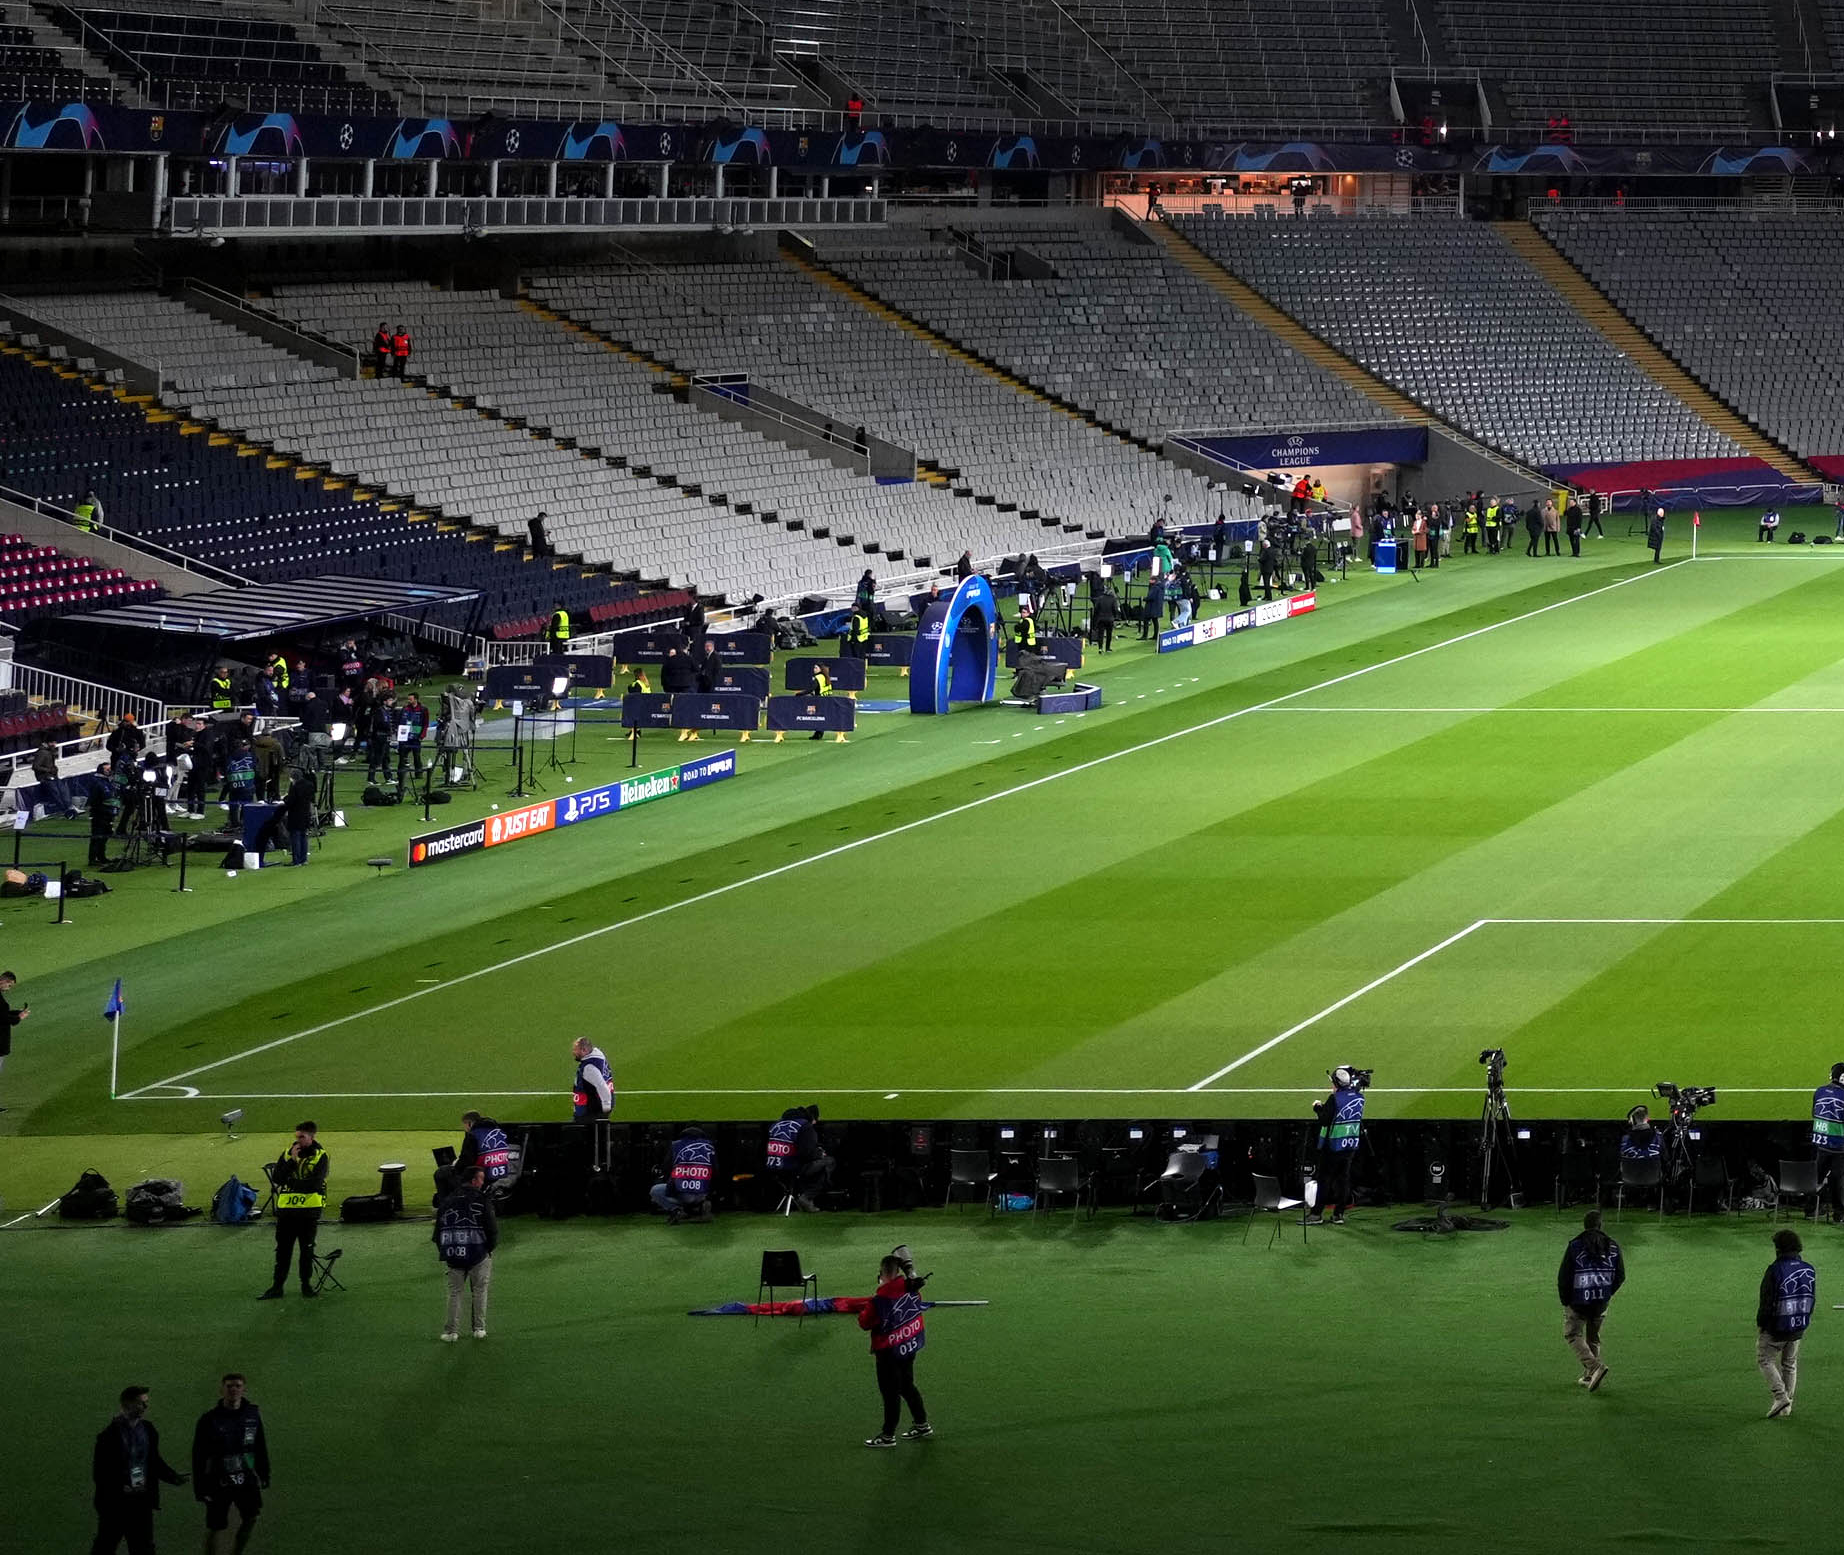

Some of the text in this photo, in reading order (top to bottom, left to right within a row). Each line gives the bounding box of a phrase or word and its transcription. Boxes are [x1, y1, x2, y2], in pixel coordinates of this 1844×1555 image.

[1271, 446, 1320, 457] CHAMPIONS
[1279, 456, 1311, 466] LEAGUE
[620, 776, 670, 805] Heineken
[580, 790, 610, 814] PS5
[504, 806, 550, 840] JUST EAT
[428, 825, 485, 857] mastercard
[1345, 1125, 1359, 1134] TV
[1341, 1138, 1359, 1148] 097
[1812, 1133, 1828, 1144] 123
[768, 1143, 790, 1154] HOTO
[484, 1152, 509, 1164] PHOT
[675, 1167, 709, 1177] PHOTO
[682, 1180, 701, 1190] 008
[888, 1319, 921, 1346] PHOTO
[899, 1336, 918, 1356] 015
